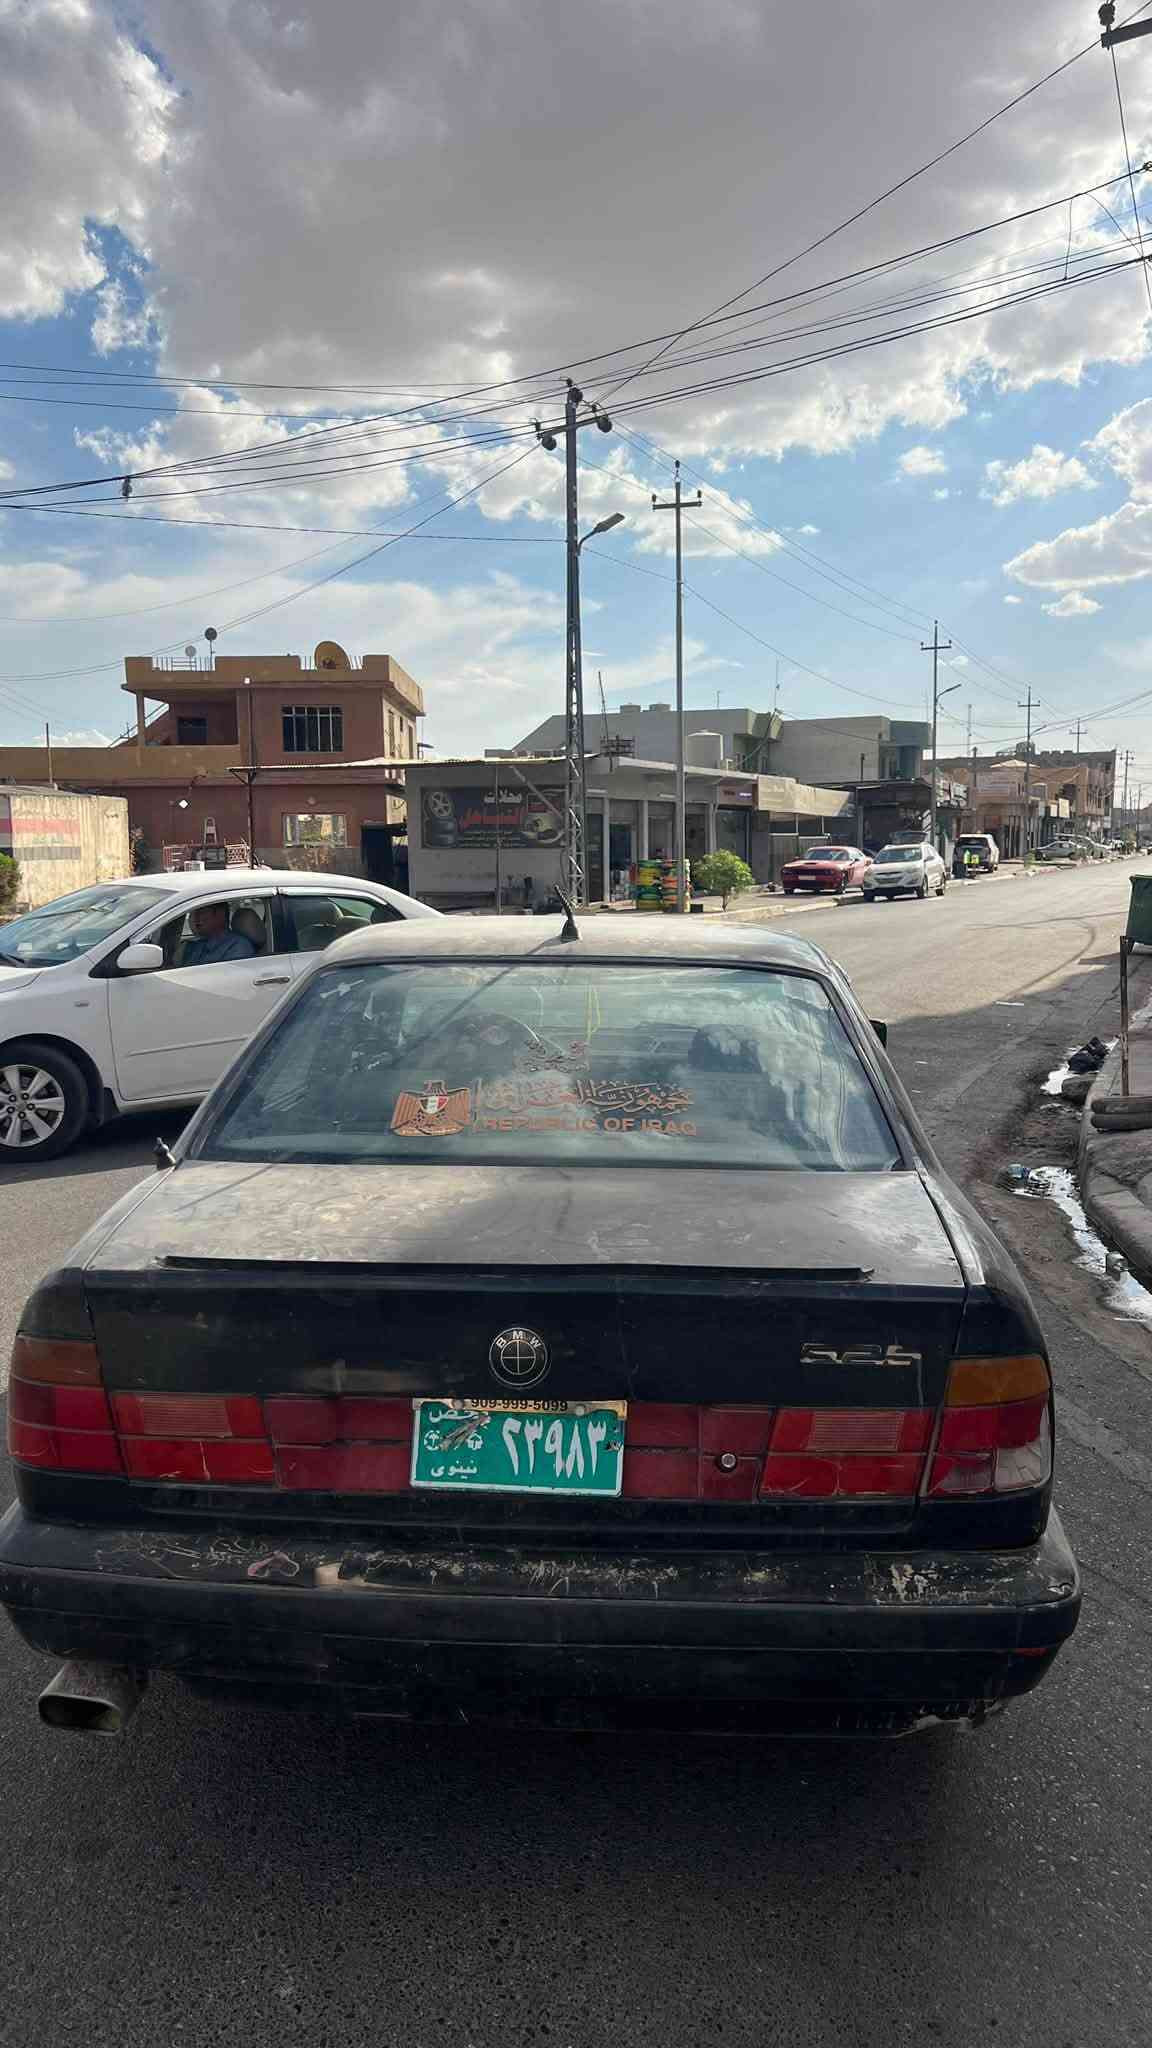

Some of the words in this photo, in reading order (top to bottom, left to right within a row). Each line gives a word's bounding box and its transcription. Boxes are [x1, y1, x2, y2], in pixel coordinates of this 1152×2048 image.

[483, 789, 522, 804] محلات
[603, 1117, 635, 1132] OF
[640, 1119, 697, 1137] IRAQ
[495, 1330, 542, 1349] BMW
[502, 1417, 606, 1479] ٢٣٩٨٣
